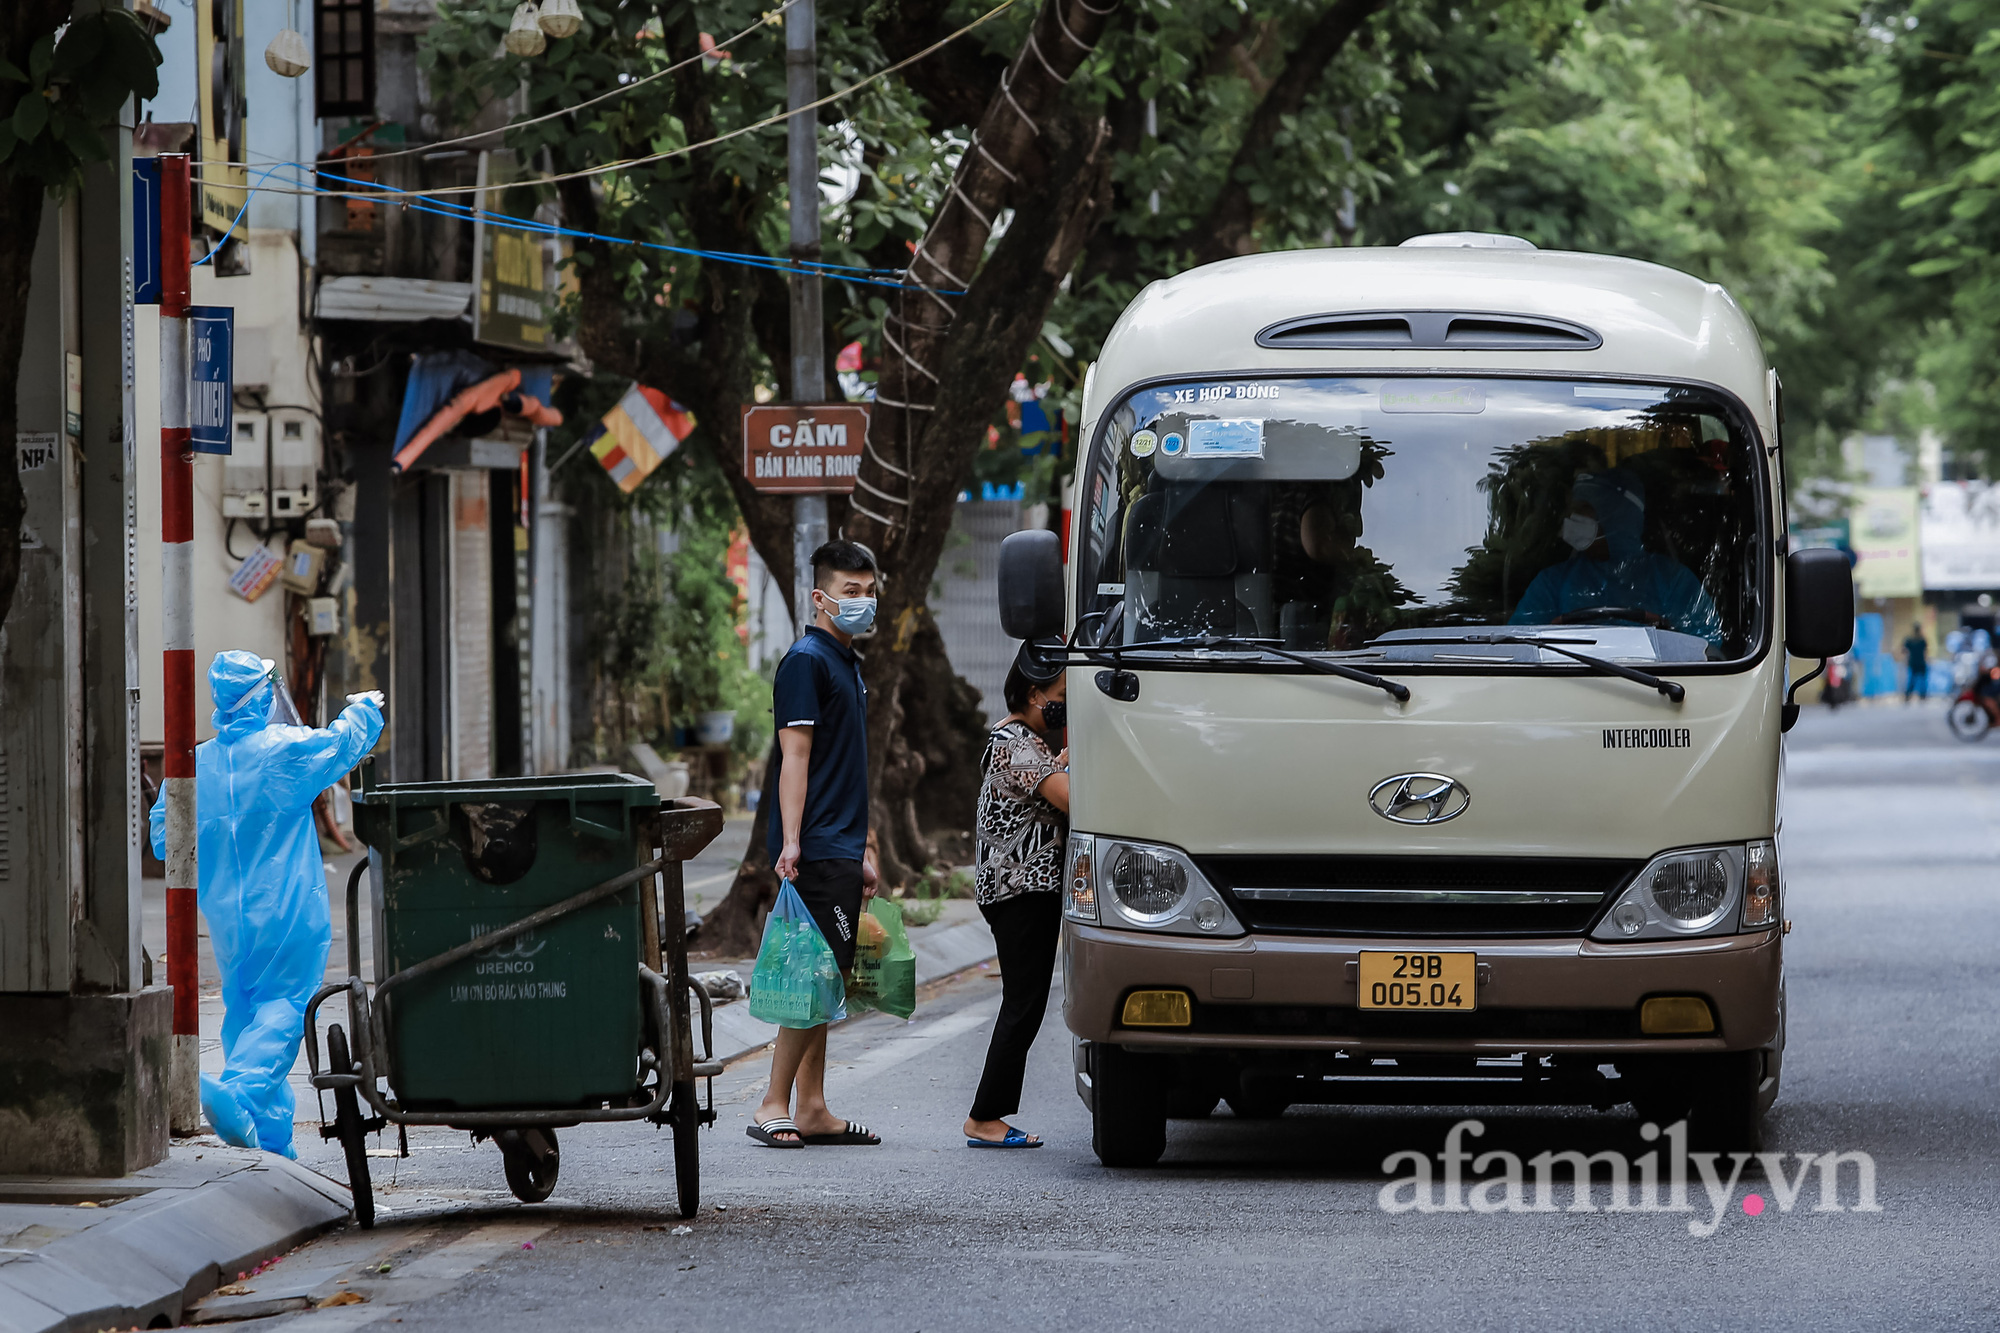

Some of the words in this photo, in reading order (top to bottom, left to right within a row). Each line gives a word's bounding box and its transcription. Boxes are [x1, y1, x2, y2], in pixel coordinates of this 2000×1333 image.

[197, 326, 212, 362] PHỐ
[202, 366, 225, 428] MIẾU
[1174, 388, 1195, 404] XE
[1200, 386, 1232, 404] HỢP
[1236, 383, 1280, 399] ĐỒNG
[769, 417, 848, 449] CẤM
[1135, 438, 1152, 446] 12/21
[755, 451, 784, 478] BÁN
[785, 450, 823, 478] HÀNG
[1602, 728, 1691, 748] INTERCOOLER
[833, 905, 851, 939] adidas
[475, 960, 534, 975] URENCO
[1392, 954, 1442, 978] 29B
[1371, 982, 1463, 1007] 005.04
